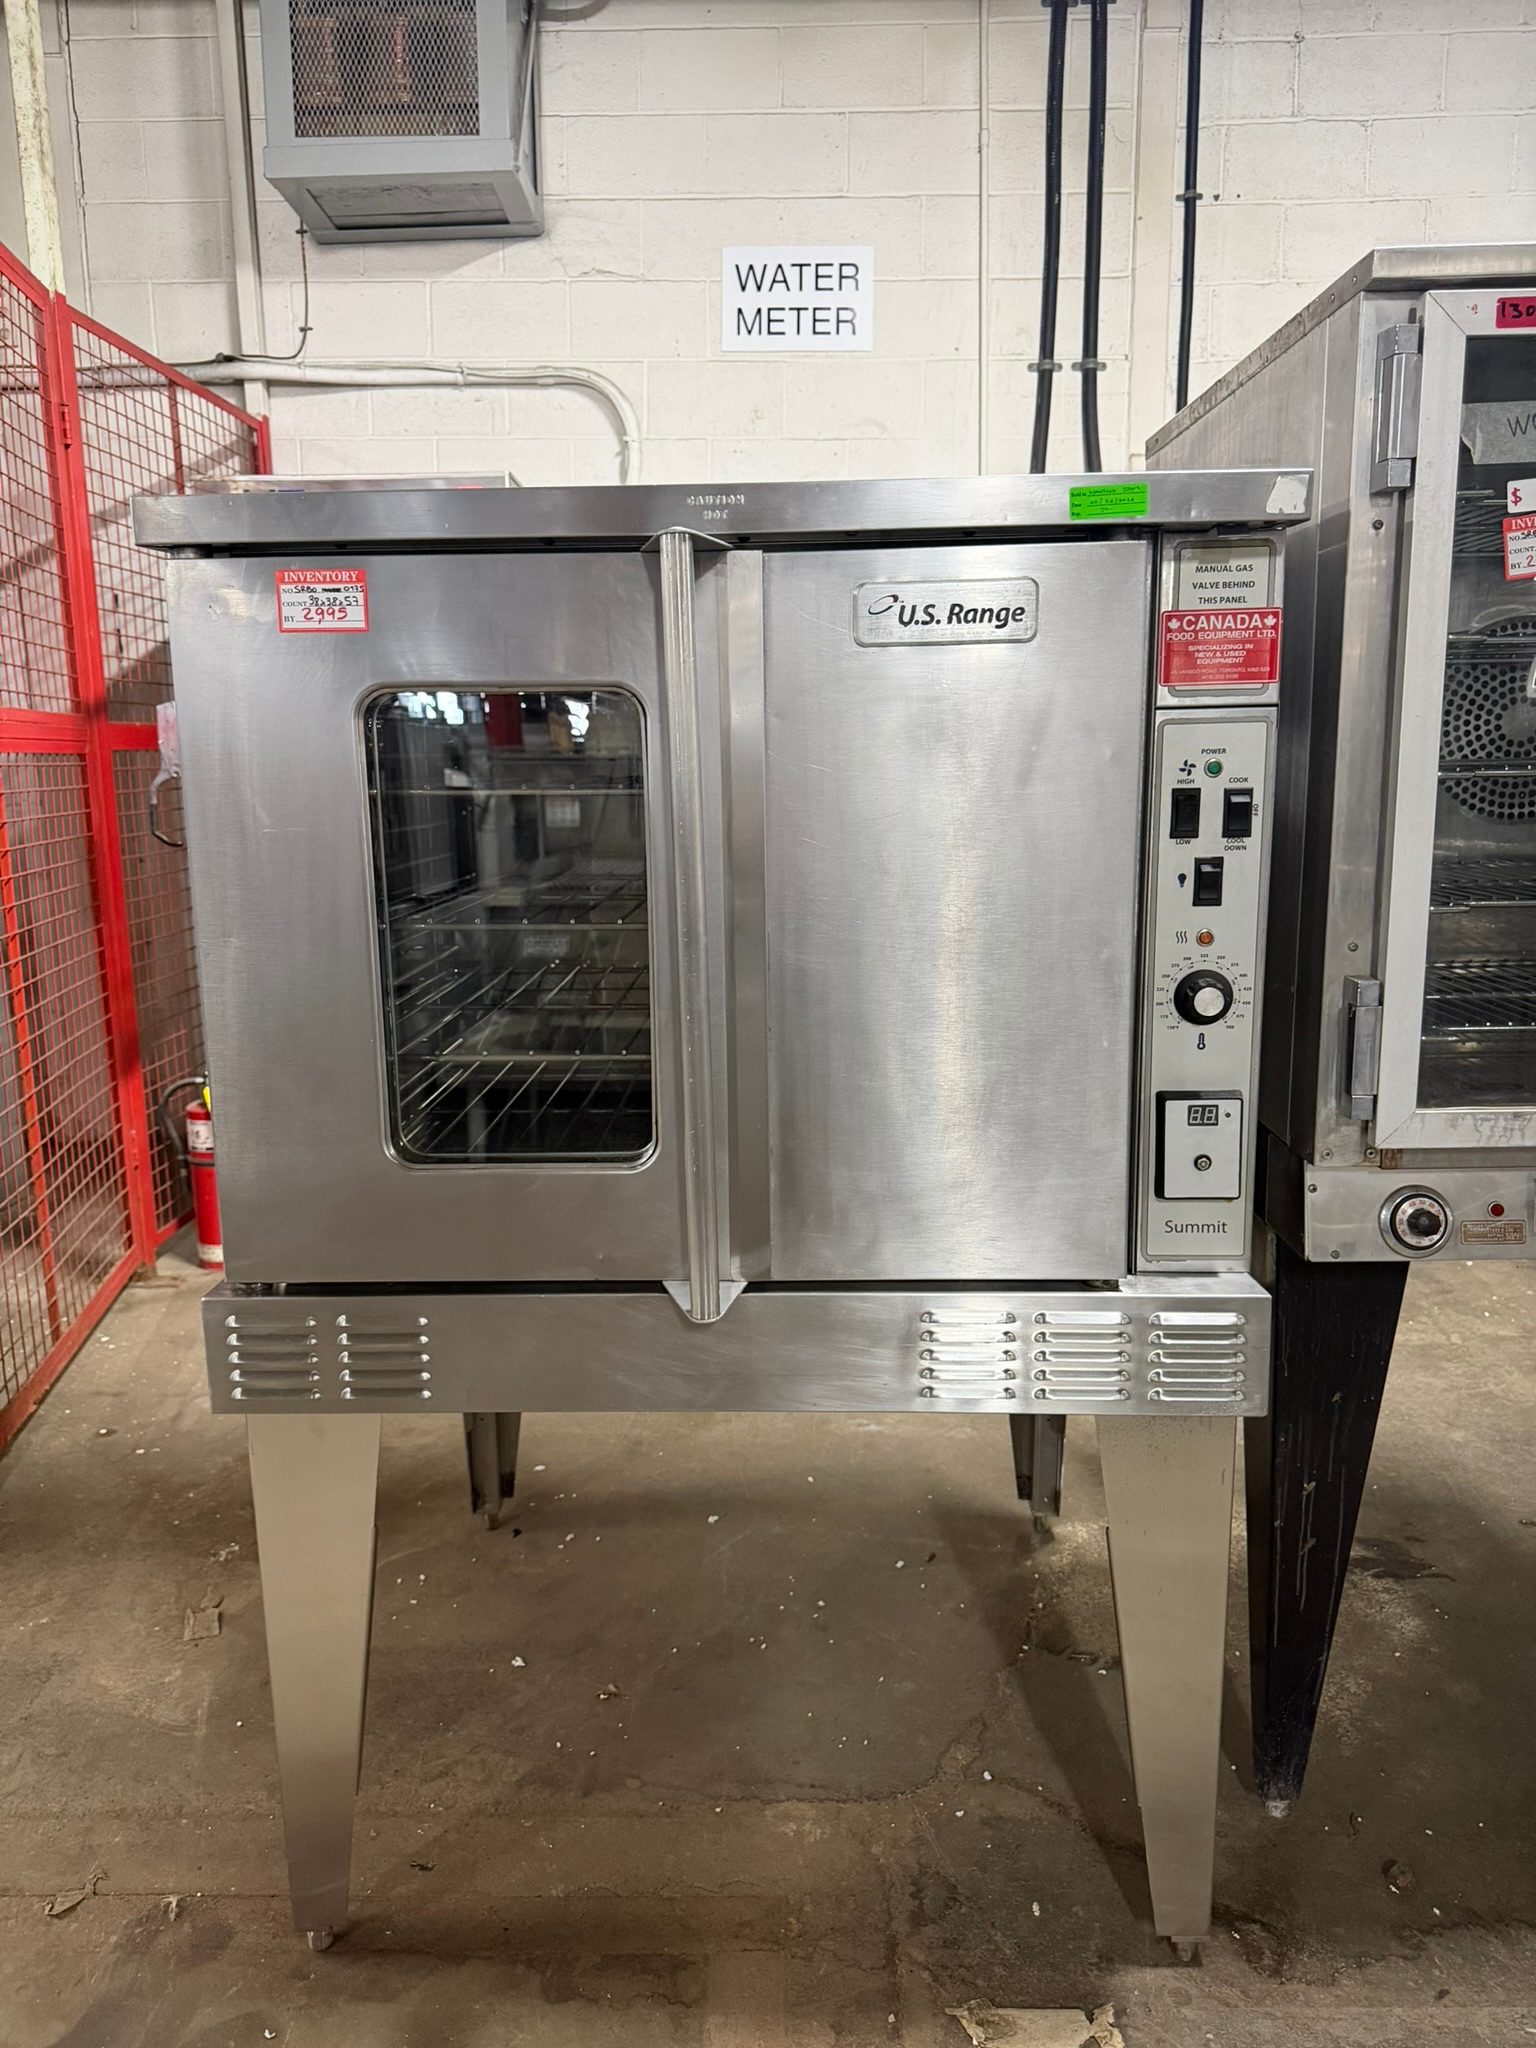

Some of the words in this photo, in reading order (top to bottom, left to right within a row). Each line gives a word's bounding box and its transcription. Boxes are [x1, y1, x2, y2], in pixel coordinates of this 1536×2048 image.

[734, 263, 860, 292] WATER
[737, 307, 857, 336] METER
[686, 494, 745, 505] CAUTION
[703, 509, 729, 520] HOT
[1195, 564, 1233, 573] MANUAL
[1235, 564, 1254, 572] GAS
[284, 571, 359, 582] INVENTORY
[1192, 581, 1220, 590] VALVE
[1221, 580, 1256, 589] BEHIND
[1198, 597, 1218, 605] THIS
[1219, 596, 1248, 604] PANEL
[898, 603, 941, 627] U.S.
[946, 603, 1026, 629] Range
[1182, 613, 1263, 631] CANADA
[1167, 632, 1195, 640] FOOD
[1198, 630, 1255, 640] EQUIPMENT
[1257, 629, 1277, 638] LTD.
[1188, 643, 1243, 651] SPECIALIZING
[1196, 657, 1244, 665] EQUIPMENT
[1164, 1219, 1228, 1234] Summit
